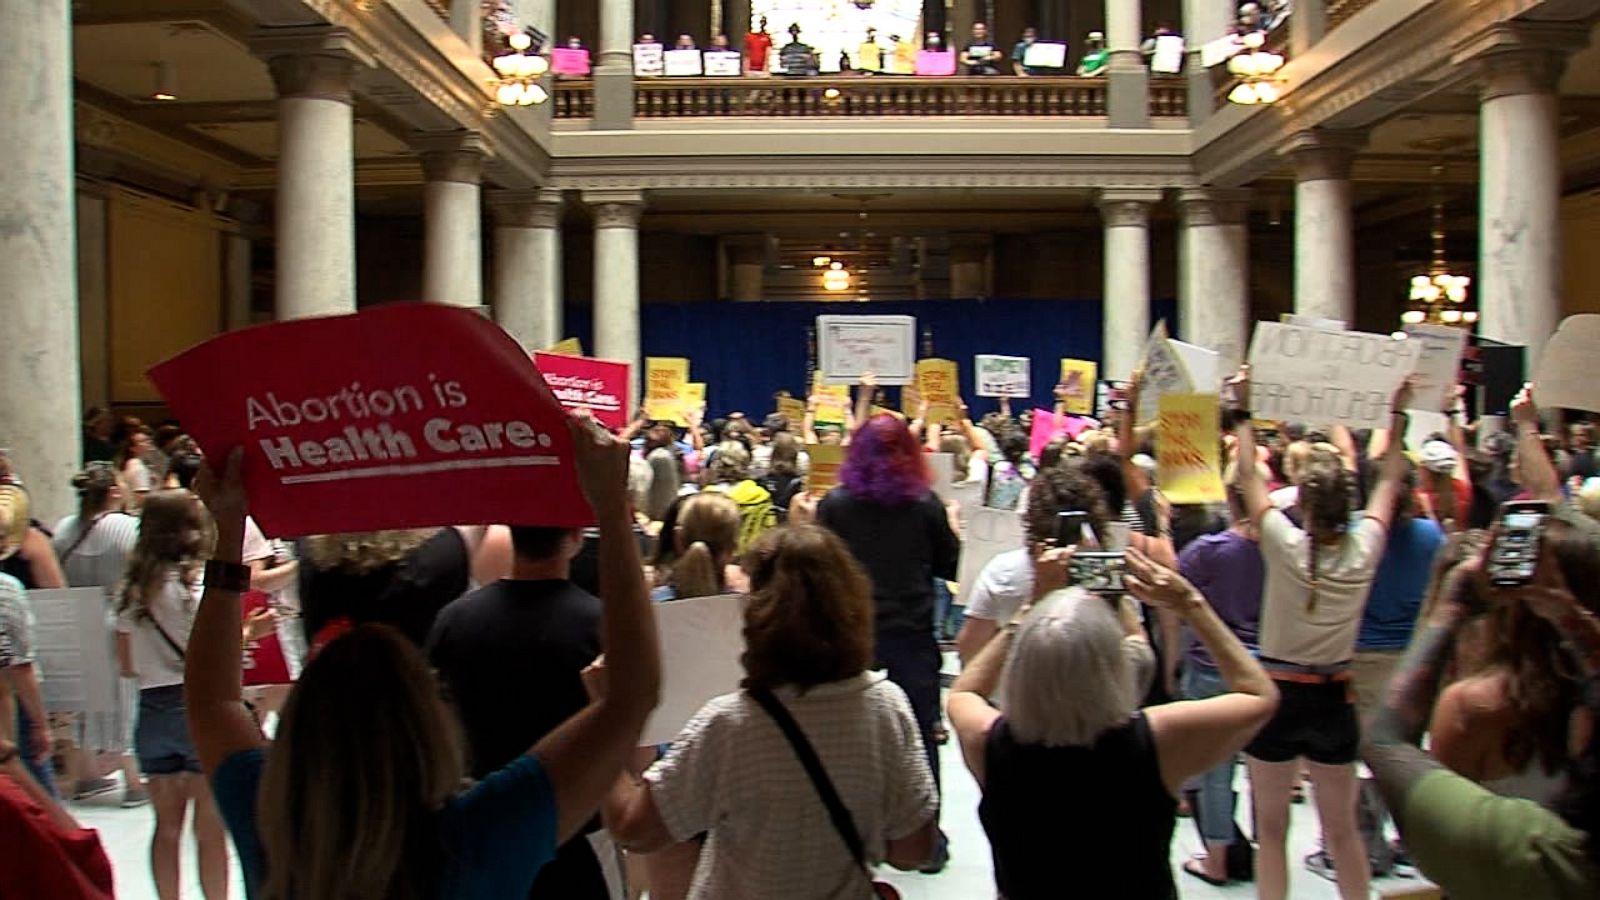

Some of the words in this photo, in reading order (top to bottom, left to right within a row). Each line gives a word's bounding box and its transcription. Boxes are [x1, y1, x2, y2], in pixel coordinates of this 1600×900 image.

[246, 381, 423, 430] Abortion
[428, 373, 467, 408] is
[259, 421, 417, 469] Health
[423, 416, 551, 452] Care.
